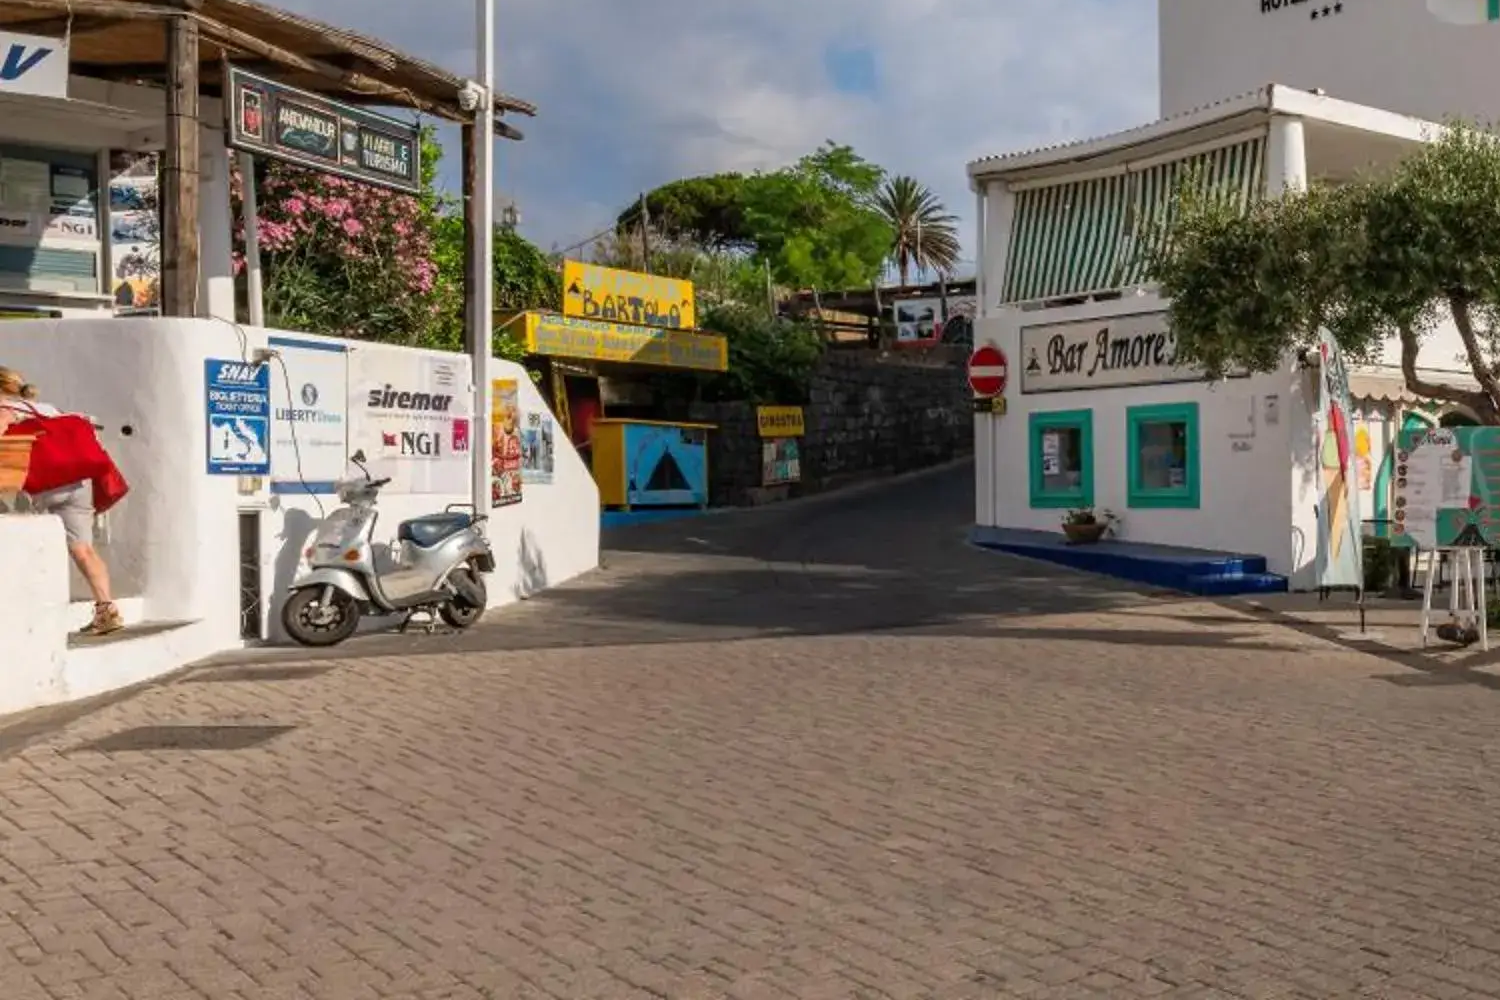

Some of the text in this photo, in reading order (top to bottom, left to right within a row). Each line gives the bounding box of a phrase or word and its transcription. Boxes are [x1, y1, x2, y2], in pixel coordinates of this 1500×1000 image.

[1047, 333, 1088, 374] Bar
[1088, 327, 1166, 377] Amore
[217, 363, 262, 381] SNAV
[367, 383, 453, 412] siremar
[401, 431, 441, 456] NGI
